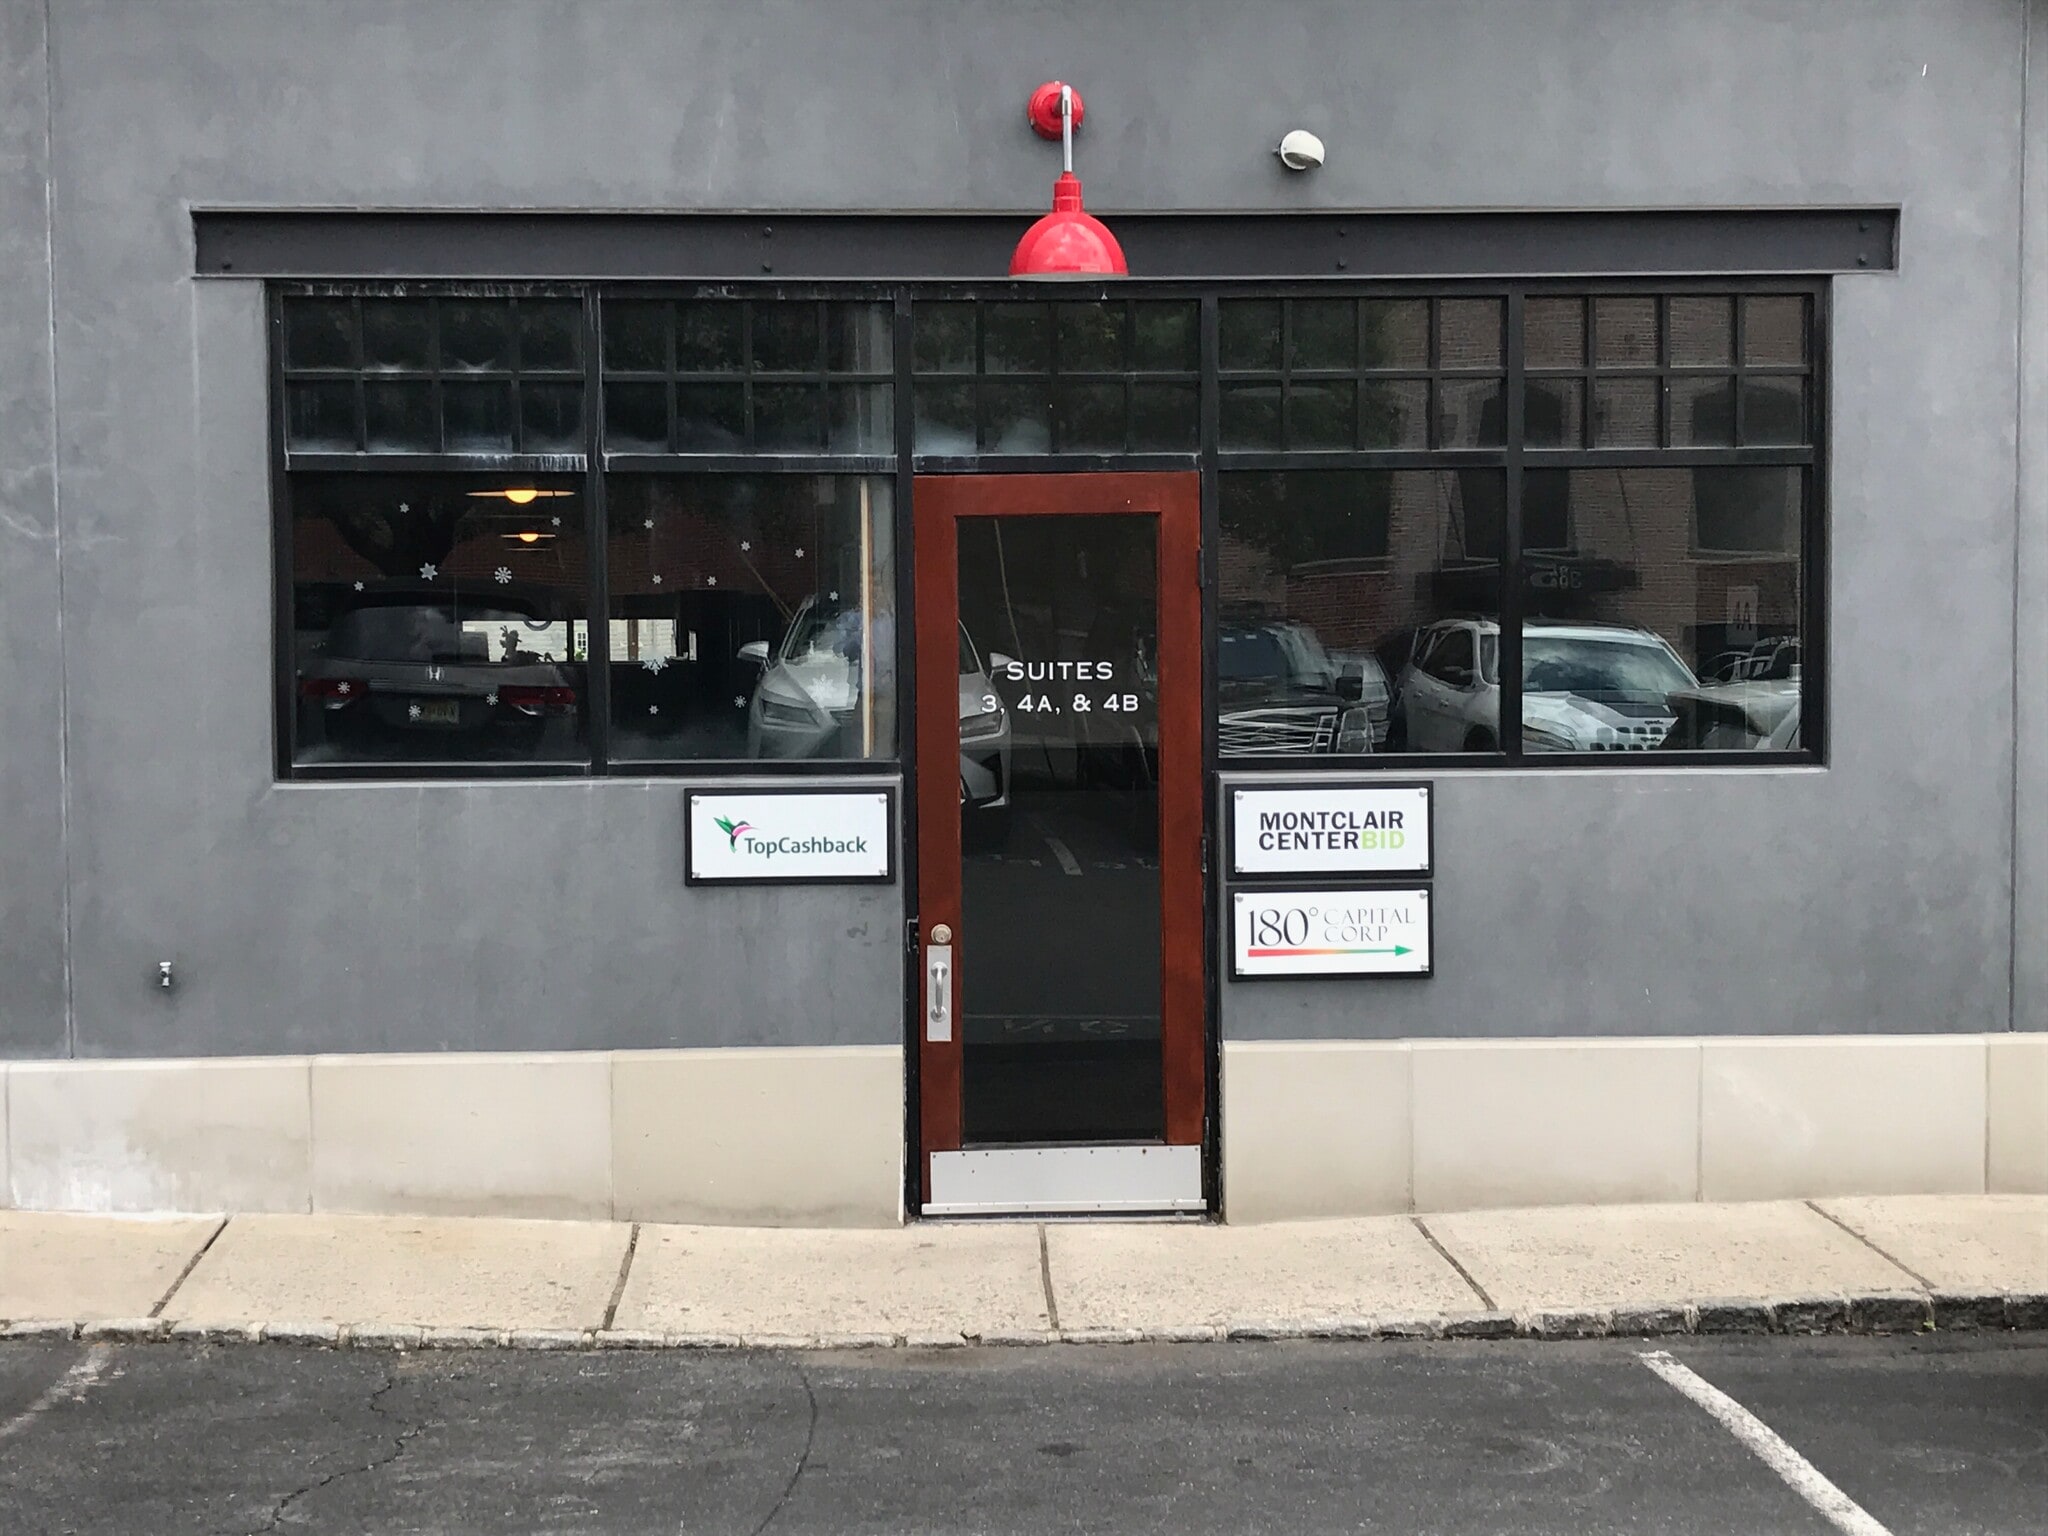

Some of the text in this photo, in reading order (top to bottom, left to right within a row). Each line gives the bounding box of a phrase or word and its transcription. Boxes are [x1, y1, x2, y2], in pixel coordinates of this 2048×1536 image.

[1006, 661, 1113, 681] SUITES
[981, 694, 1139, 715] 3, 4A, & 4B
[1259, 811, 1404, 831] MONTCLAIR
[744, 836, 867, 859] TopCashback
[1324, 908, 1416, 925] CAPITAL
[1324, 925, 1388, 942] CORP
